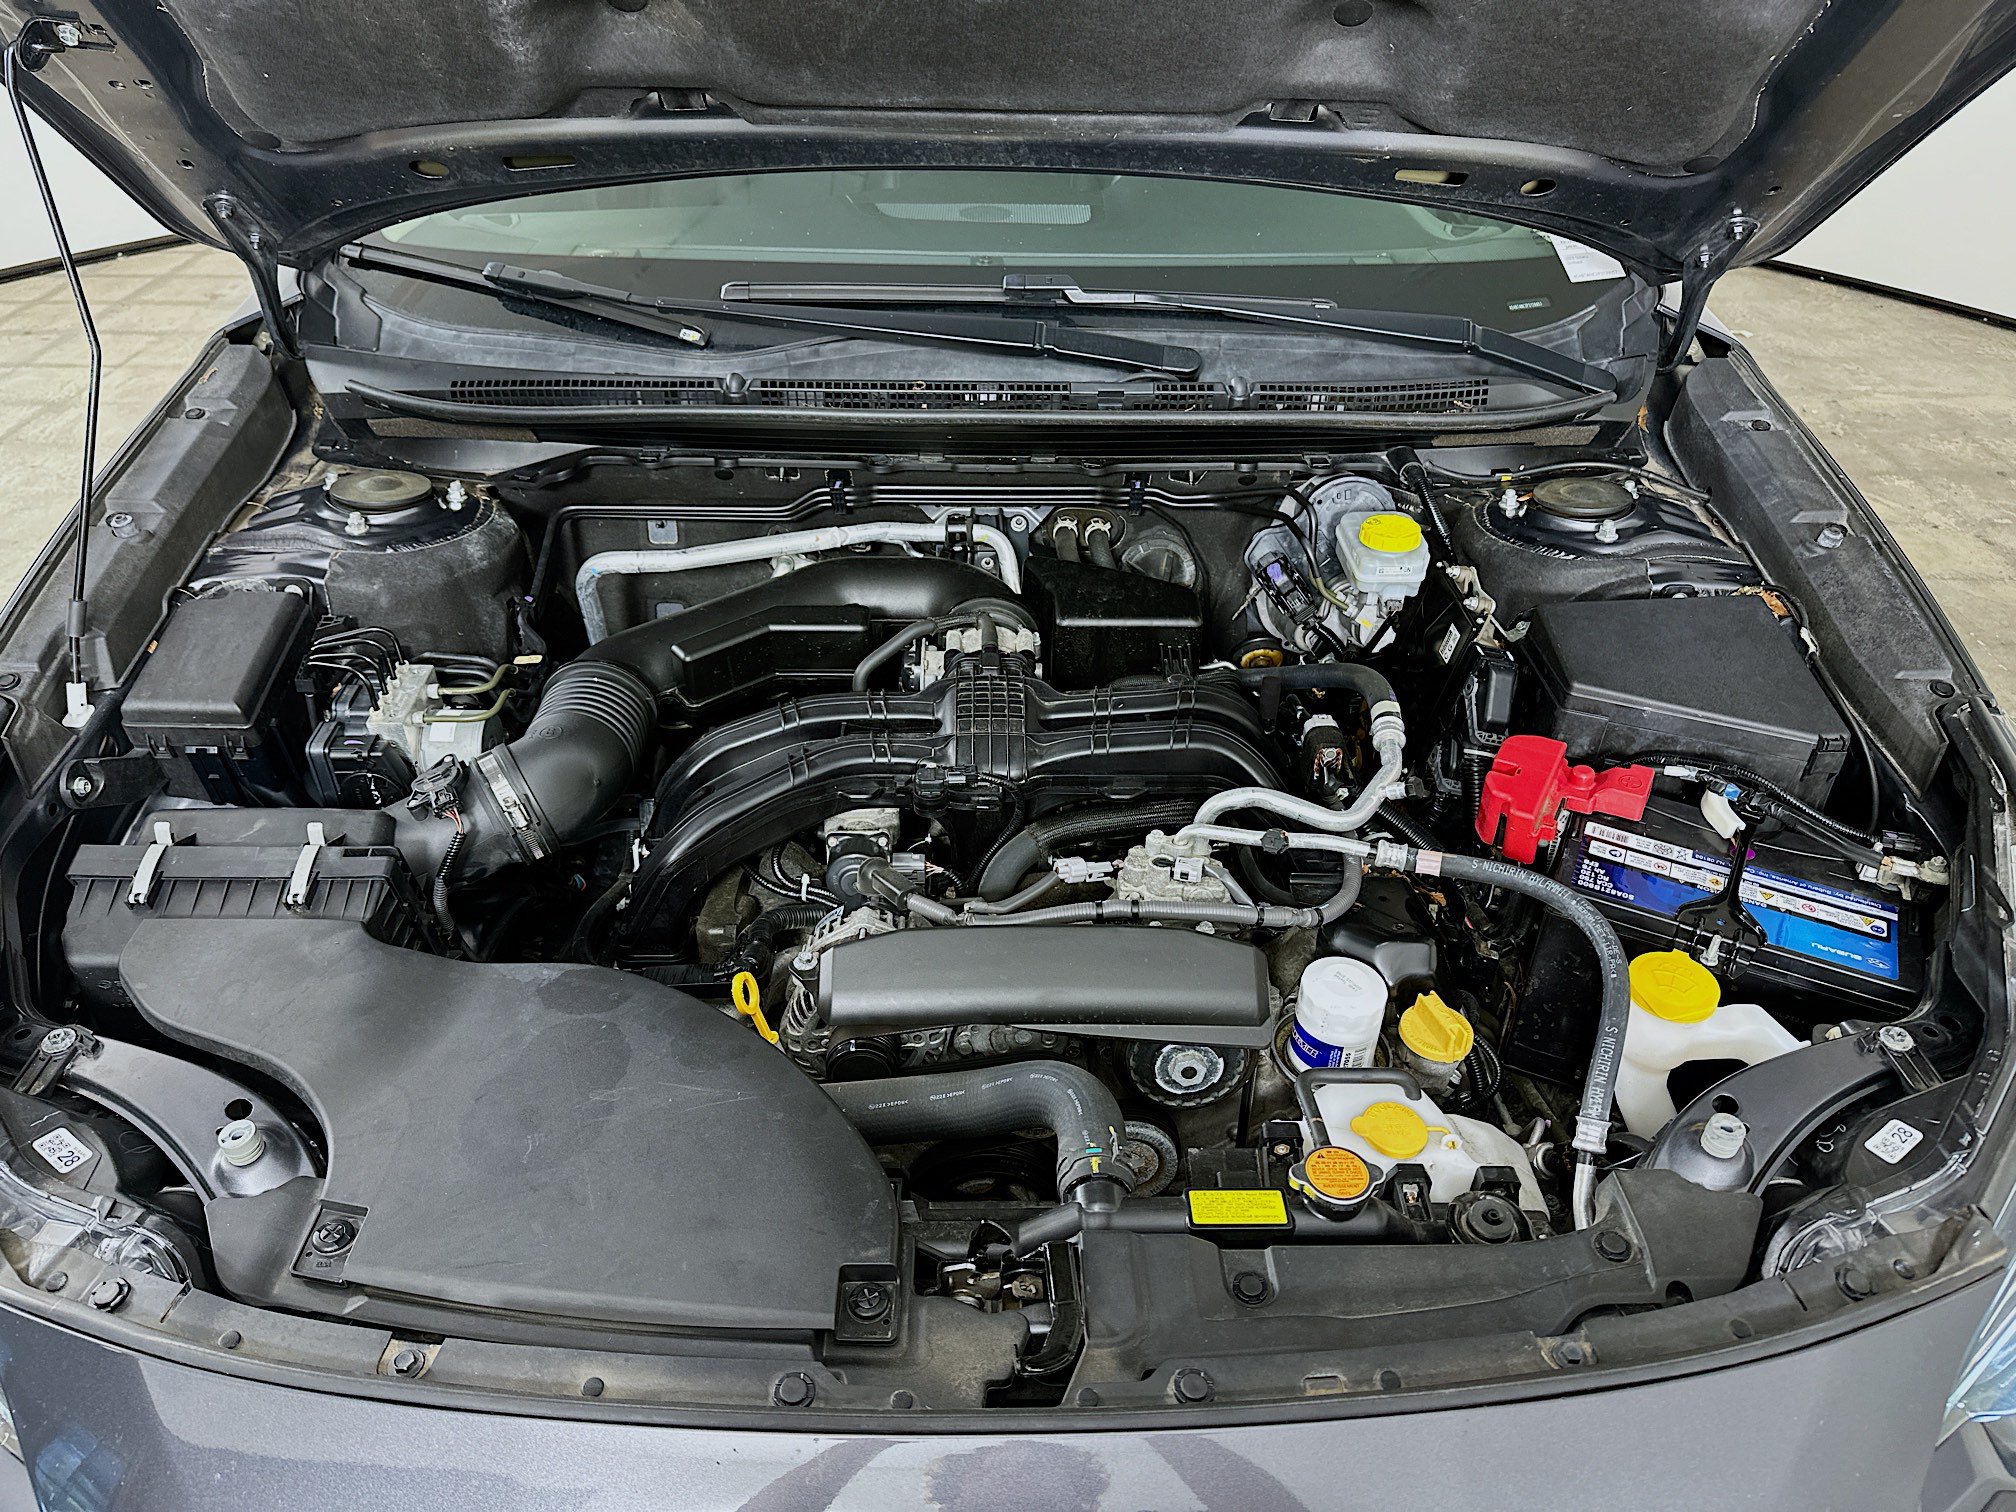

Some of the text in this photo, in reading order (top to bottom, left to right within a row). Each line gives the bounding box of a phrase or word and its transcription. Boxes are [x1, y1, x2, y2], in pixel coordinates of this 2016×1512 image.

[1580, 868, 1609, 881] RC 120
[1595, 879, 1613, 888] CCA
[1810, 941, 1862, 961] SUBARU
[1891, 1126, 1912, 1143] 28
[57, 1149, 80, 1166] 28
